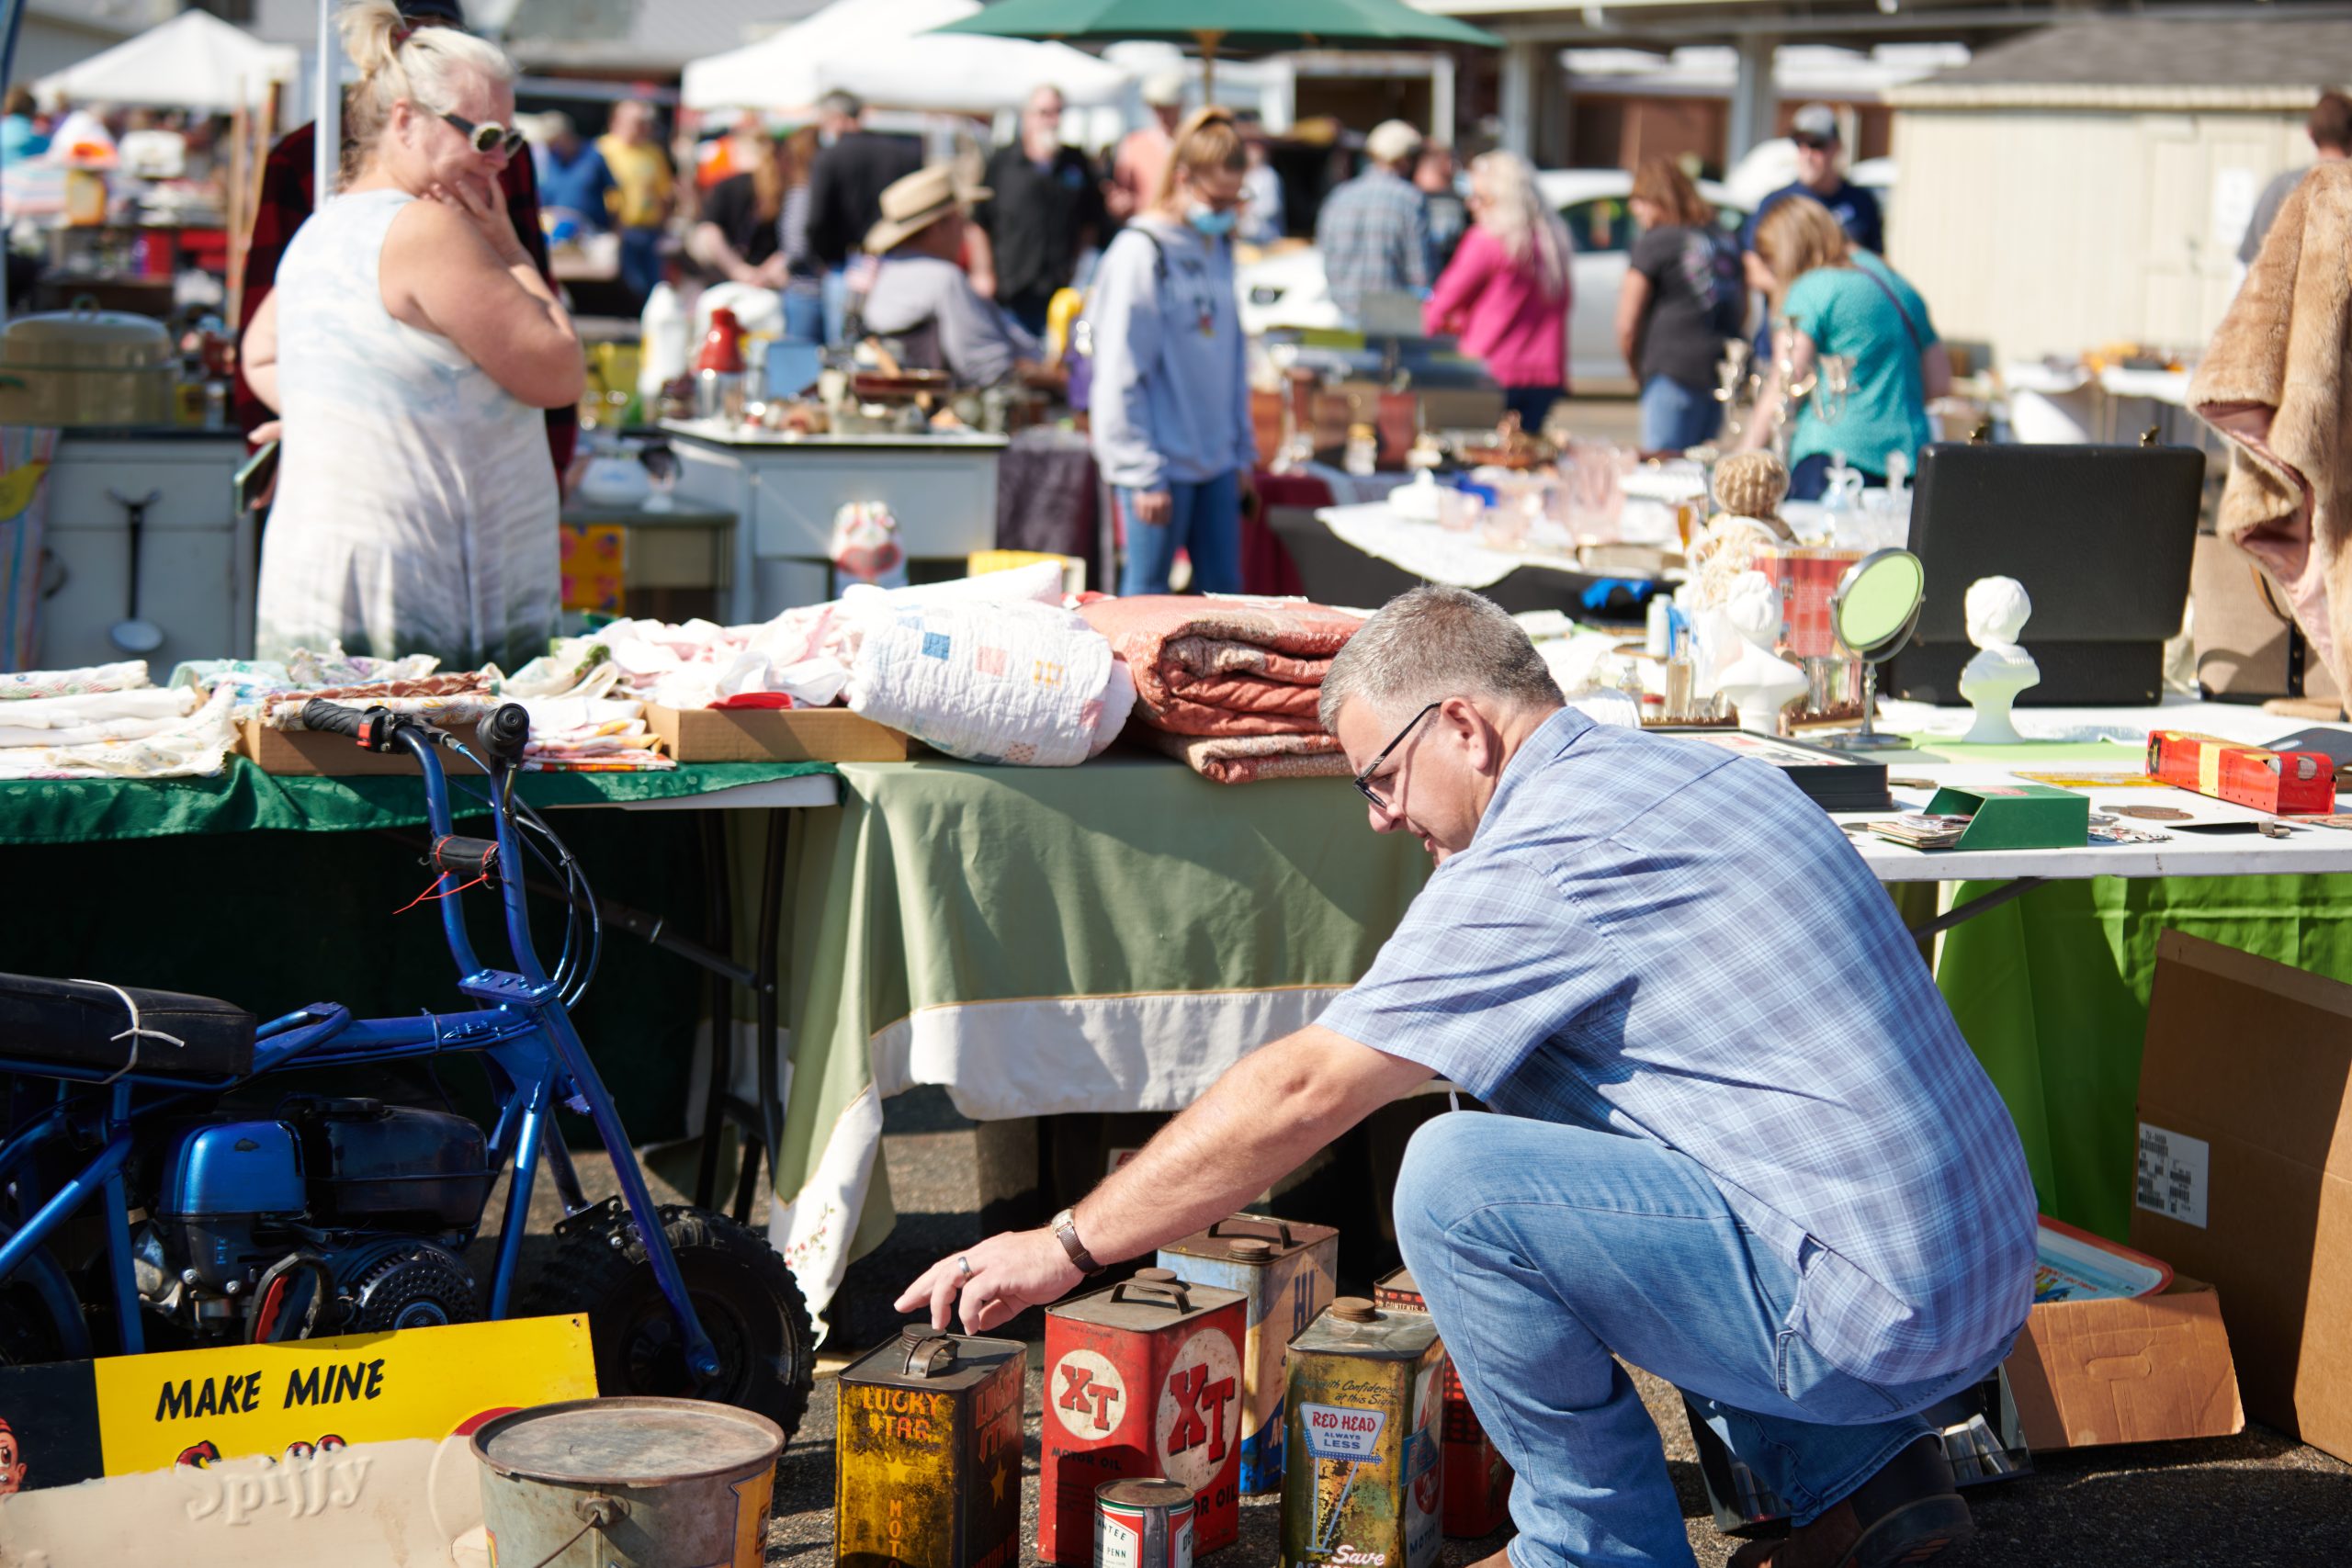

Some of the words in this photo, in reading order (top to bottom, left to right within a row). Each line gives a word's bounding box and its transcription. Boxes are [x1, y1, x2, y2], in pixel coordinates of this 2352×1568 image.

[1385, 1301, 1419, 1312] CONTENTS
[154, 1370, 262, 1422] MAKE
[283, 1358, 385, 1409] MINE
[863, 1386, 942, 1417] LUCKY
[1059, 1363, 1119, 1431] XT
[1348, 1393, 1367, 1404] this
[1167, 1362, 1236, 1465] XT
[1312, 1411, 1339, 1429] RED
[1341, 1415, 1376, 1433] HEAD
[1323, 1438, 1361, 1450] LESS
[1324, 1431, 1361, 1440] ALWAYS
[1051, 1446, 1095, 1464] MOTOR
[1100, 1456, 1122, 1470] OIL
[175, 1434, 373, 1526] Spiffy
[1216, 1483, 1238, 1508] OIL
[1106, 1546, 1126, 1559] PENN
[1332, 1544, 1385, 1566] Save
